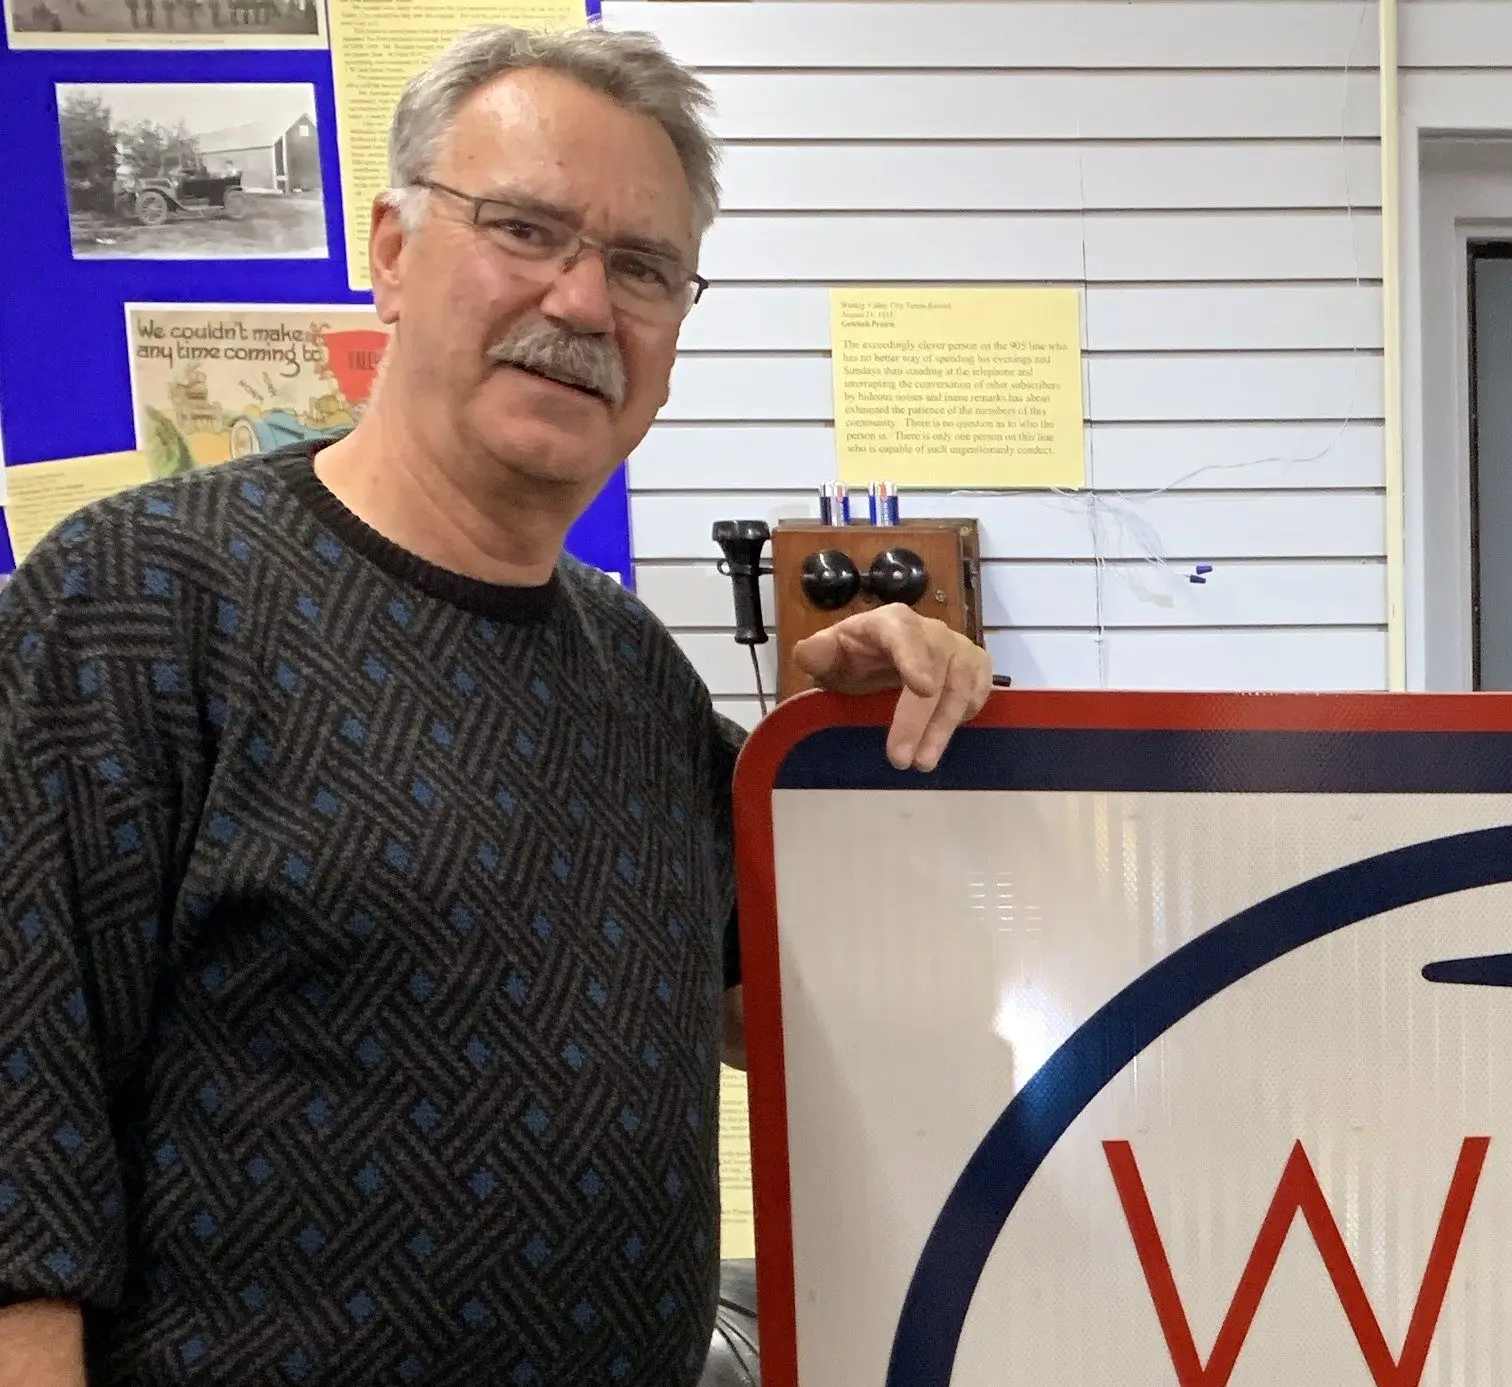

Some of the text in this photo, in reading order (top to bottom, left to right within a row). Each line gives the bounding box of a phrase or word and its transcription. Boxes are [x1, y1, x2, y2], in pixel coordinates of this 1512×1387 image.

[137, 319, 304, 342] We couldn't make
[136, 341, 323, 377] any time coming to
